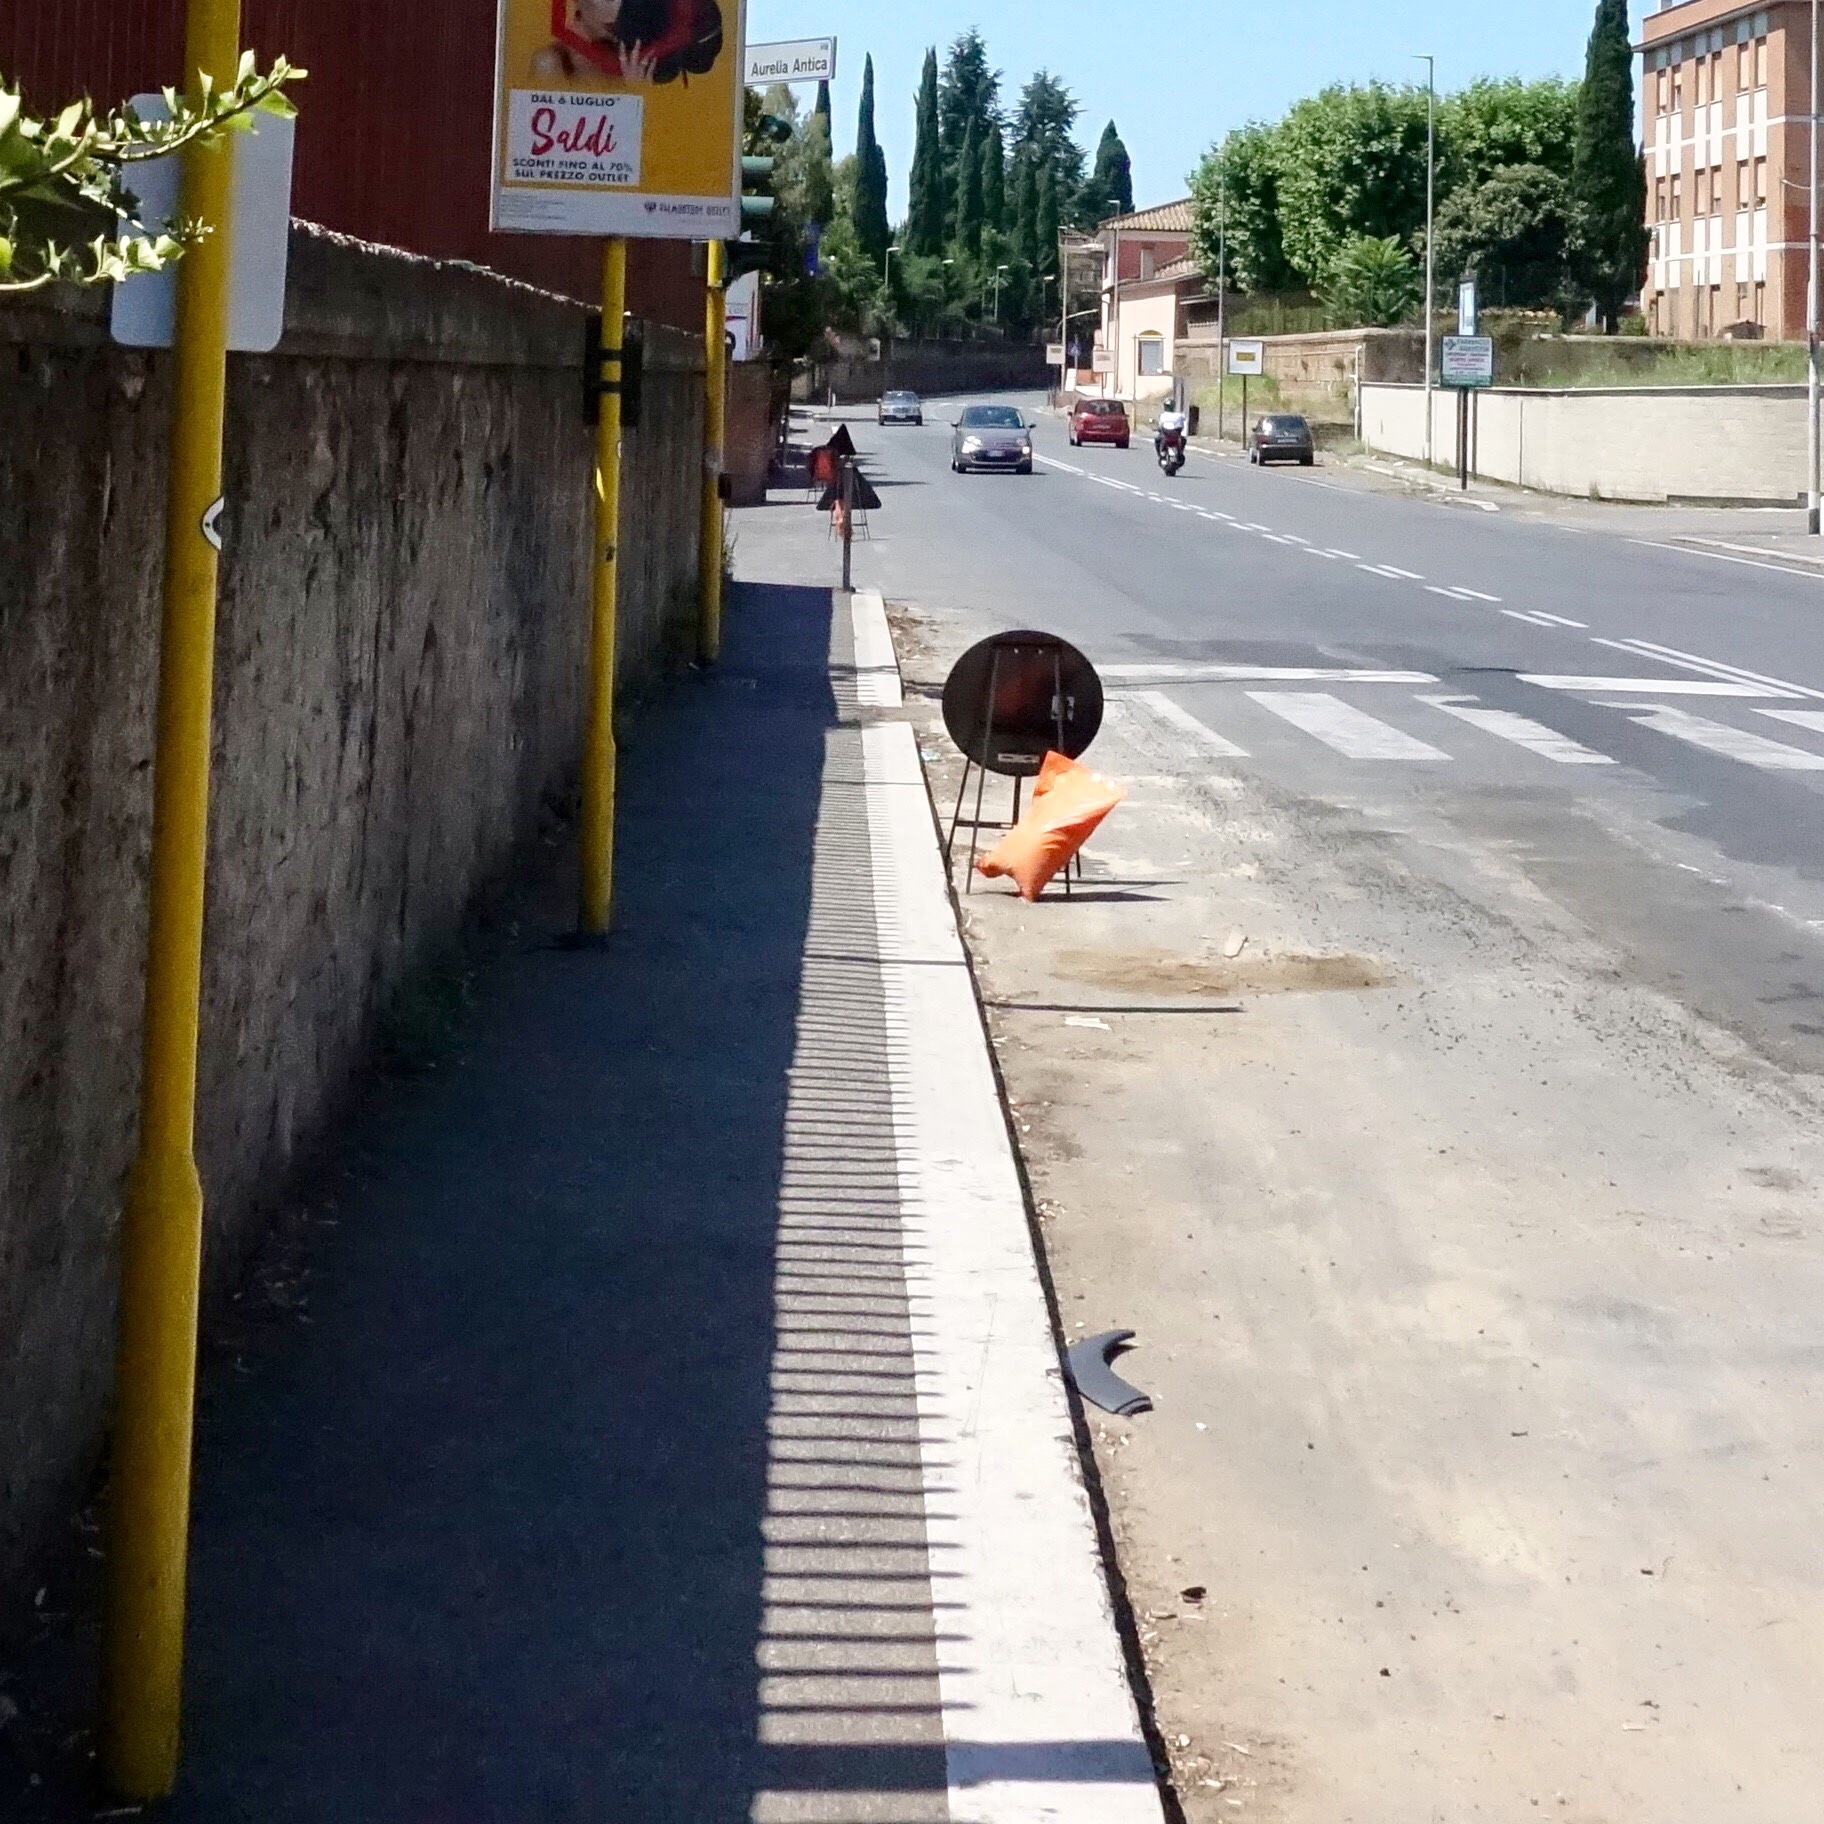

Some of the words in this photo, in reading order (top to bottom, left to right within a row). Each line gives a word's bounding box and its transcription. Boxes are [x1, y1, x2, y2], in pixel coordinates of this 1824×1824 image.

[751, 60, 789, 77] Aurelia
[793, 56, 828, 74] Antica
[531, 93, 554, 104] DAL
[531, 107, 617, 157] Saldi
[513, 158, 555, 168] SCONTI
[558, 160, 587, 169] FINO
[592, 162, 604, 171] AL
[609, 162, 633, 172] 70%
[514, 169, 535, 178] SUL
[540, 170, 584, 180] PREZZO
[589, 172, 629, 182] OUTLET
